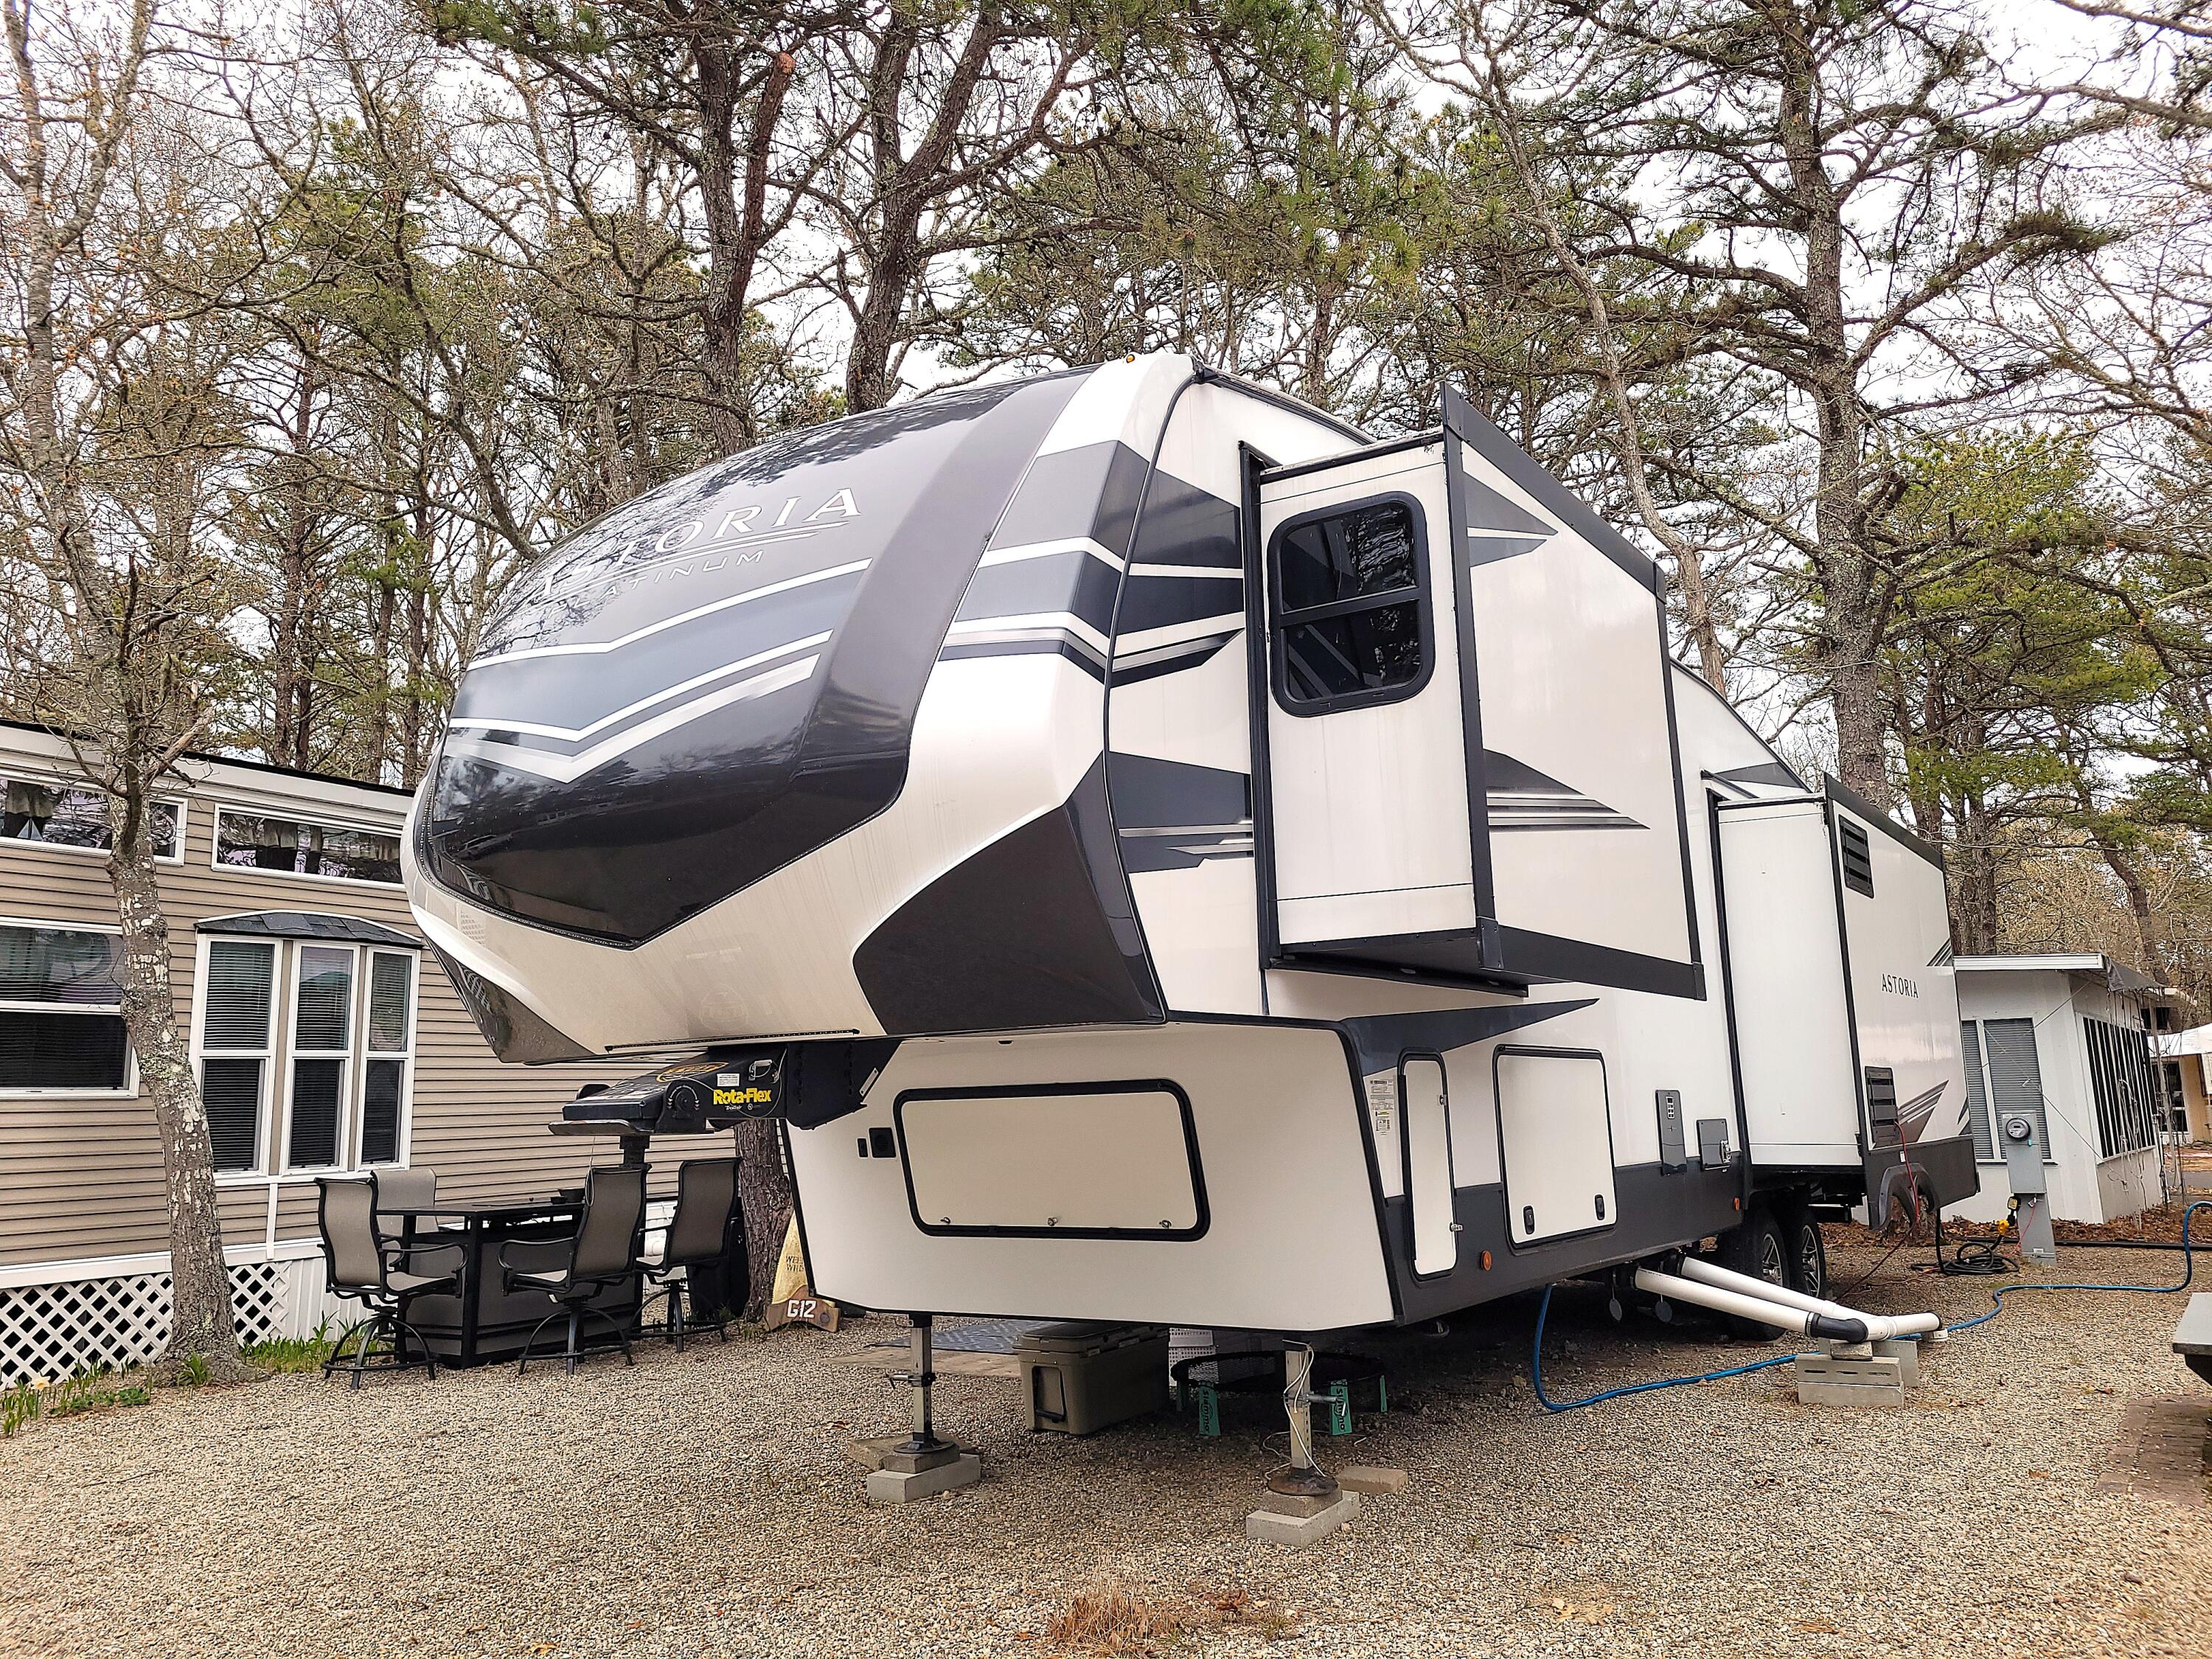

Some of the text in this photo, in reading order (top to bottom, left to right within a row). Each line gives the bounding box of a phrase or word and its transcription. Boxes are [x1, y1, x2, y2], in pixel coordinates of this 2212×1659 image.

[547, 549, 766, 619] PLATINUM
[1882, 973, 1919, 998] ASTORIA
[787, 1299, 816, 1318] G12
